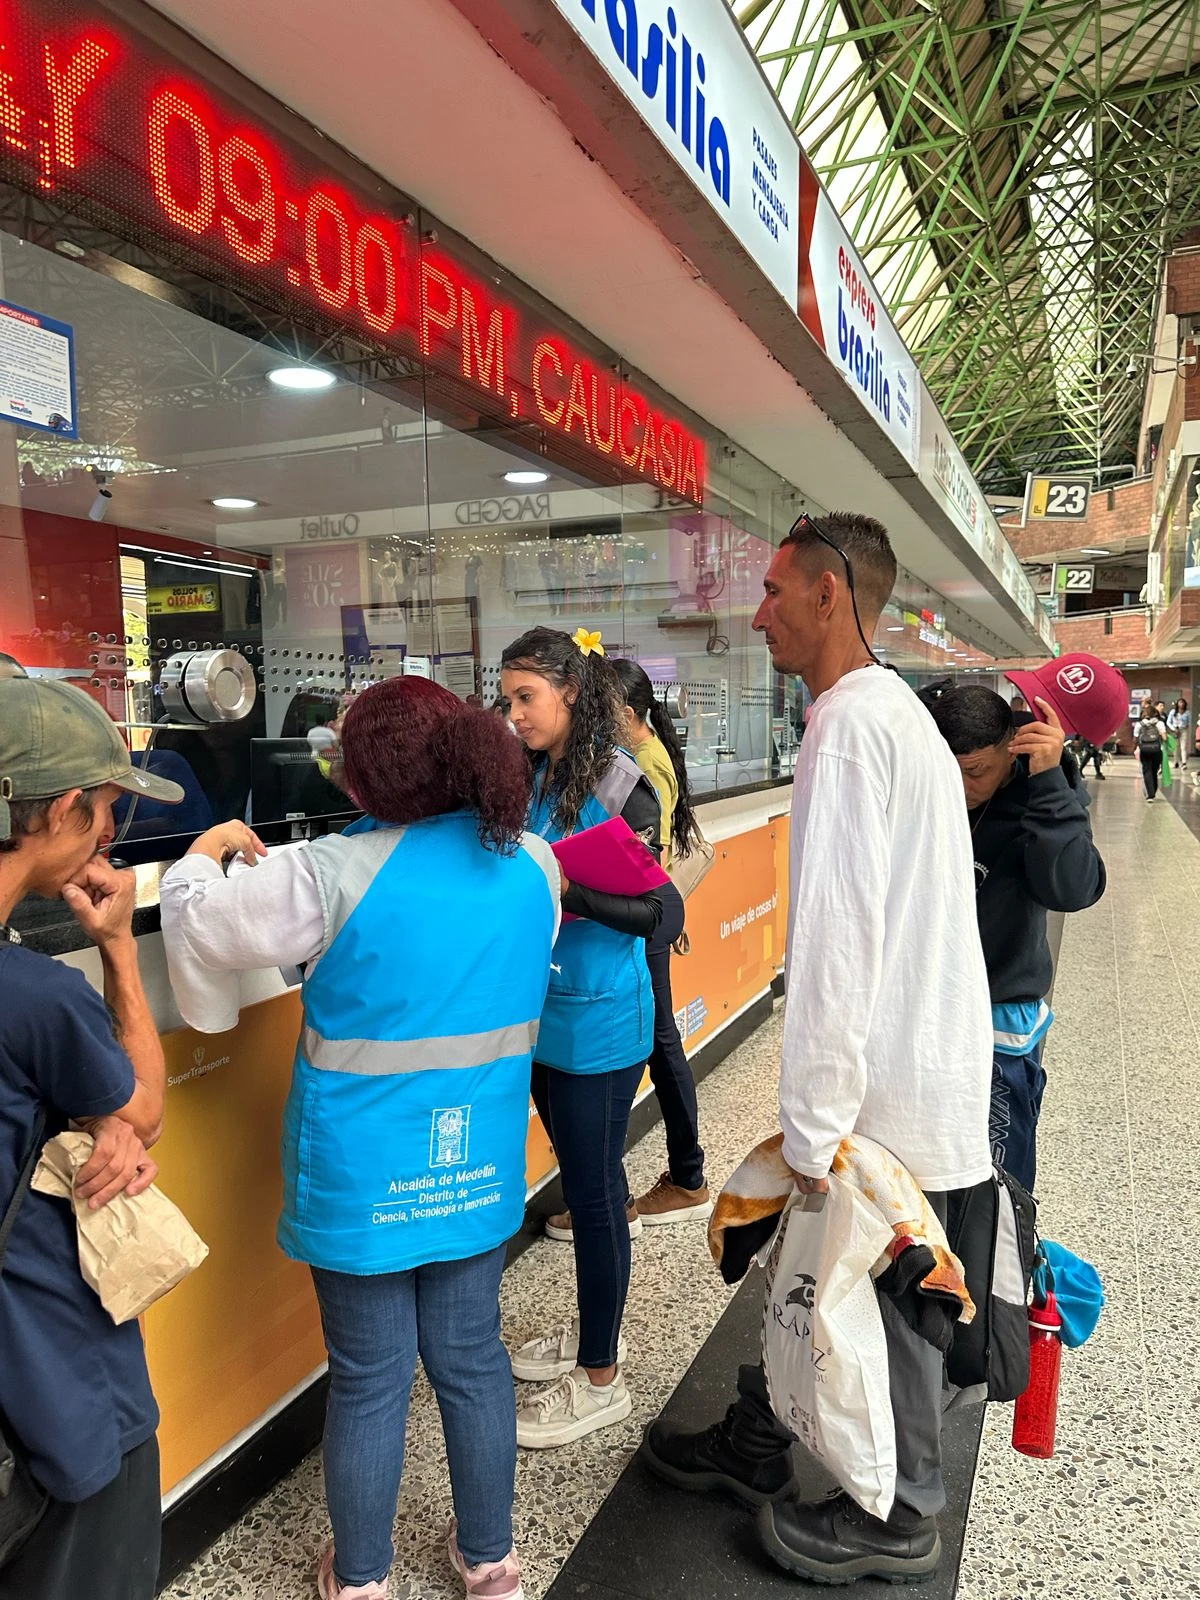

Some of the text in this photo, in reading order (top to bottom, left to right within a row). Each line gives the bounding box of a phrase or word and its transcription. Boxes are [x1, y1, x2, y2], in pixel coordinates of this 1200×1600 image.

[578, 0, 731, 208] asilia
[752, 126, 777, 181] PASAJES
[752, 160, 789, 231] MENSAJERÍA
[752, 187, 779, 243] Y CARGA
[148, 90, 397, 333] 09:00
[419, 259, 520, 418] PM,
[837, 285, 891, 424] brasilia
[1046, 485, 1087, 514] 23
[1066, 570, 1092, 589] 22
[720, 921, 730, 940] Un
[731, 911, 746, 933] viaje
[746, 906, 755, 924] de
[755, 899, 772, 919] cosas
[167, 1055, 231, 1087] SuperTransporte
[388, 1162, 496, 1195] Alcaldía de Medellín
[418, 1187, 469, 1205] Distrito de
[372, 1189, 501, 1225] Ciencia, Tecnología e Innovación
